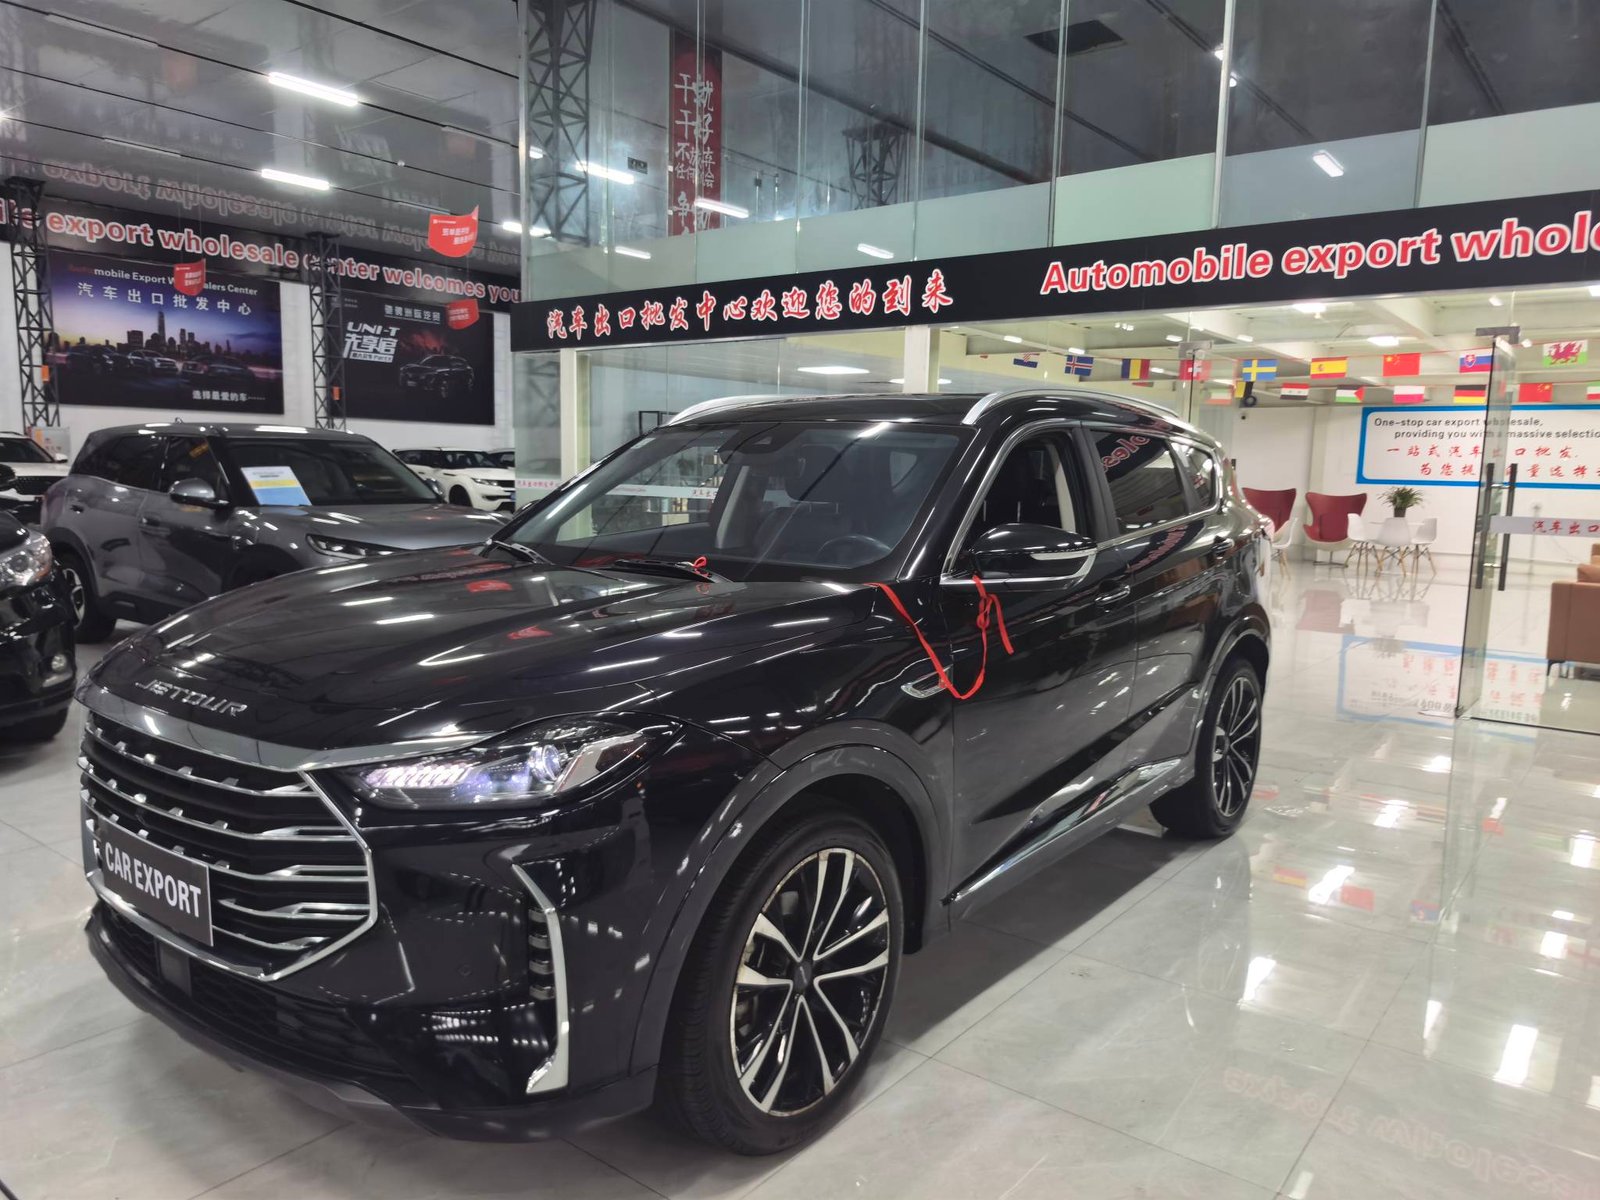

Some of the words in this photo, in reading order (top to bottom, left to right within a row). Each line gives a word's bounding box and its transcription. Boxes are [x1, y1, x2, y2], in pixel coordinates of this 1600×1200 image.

[46, 212, 153, 246] export
[158, 228, 299, 268] wholesale
[383, 266, 485, 297] welcomes
[1040, 241, 1273, 295] Automobile
[1281, 227, 1442, 279] export
[78, 281, 252, 316] 汽车出口批发中心
[133, 272, 166, 285] Export
[227, 283, 258, 296] Center
[546, 268, 954, 341] 汽车出口批发中心欢迎您的到来
[347, 321, 400, 337] UNI-T
[1374, 418, 1424, 428] One-stop
[1426, 419, 1442, 427] car
[1444, 418, 1480, 428] export
[1394, 429, 1445, 440] providing
[1447, 430, 1467, 440] you
[1507, 429, 1552, 438] massive
[135, 679, 248, 717] JETOUR
[105, 842, 132, 884] CAR
[134, 858, 202, 917] EXPORT
